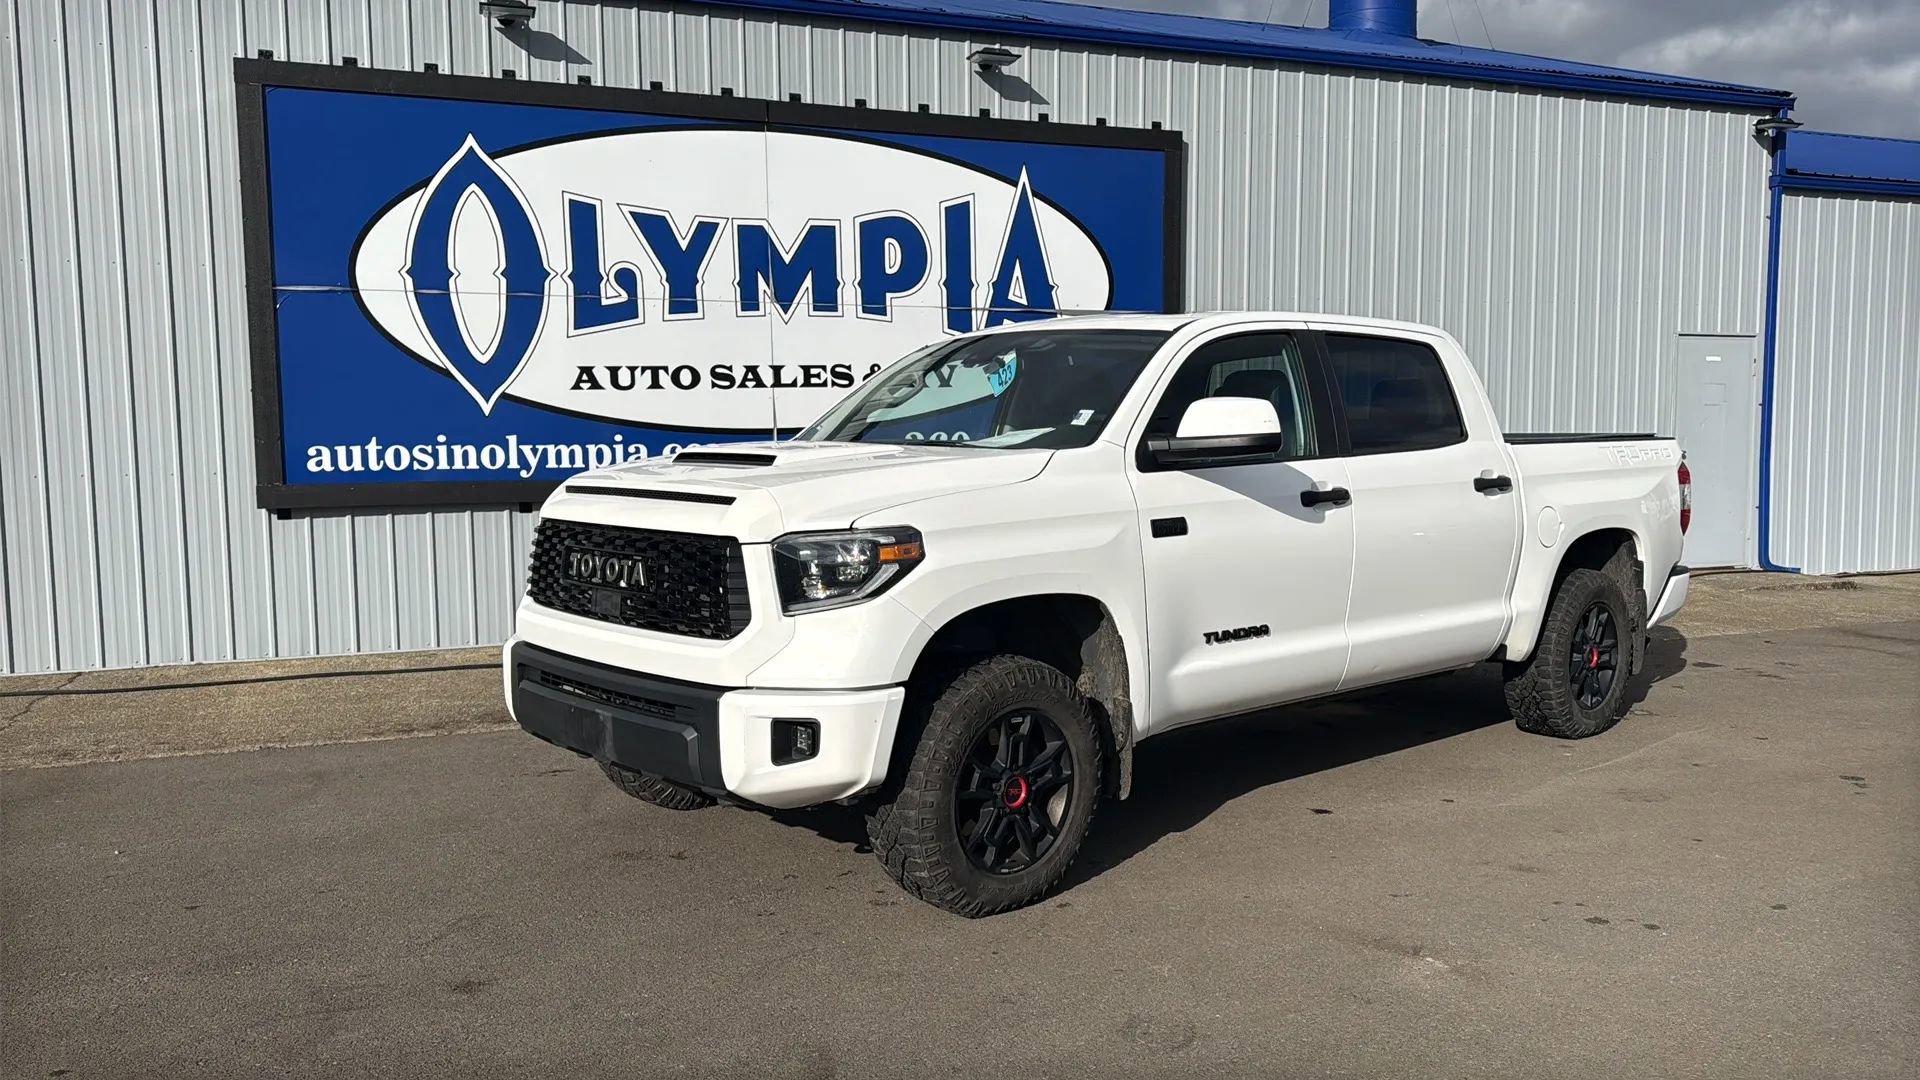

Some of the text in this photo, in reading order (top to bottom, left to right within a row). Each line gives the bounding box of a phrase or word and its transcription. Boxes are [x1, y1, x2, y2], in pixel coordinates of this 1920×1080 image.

[400, 132, 1061, 416] OLYMPIA
[570, 365, 701, 391] AUTO
[710, 364, 855, 389] SALES
[568, 552, 648, 588] TOYOTA
[1203, 624, 1270, 645] TUNDRA
